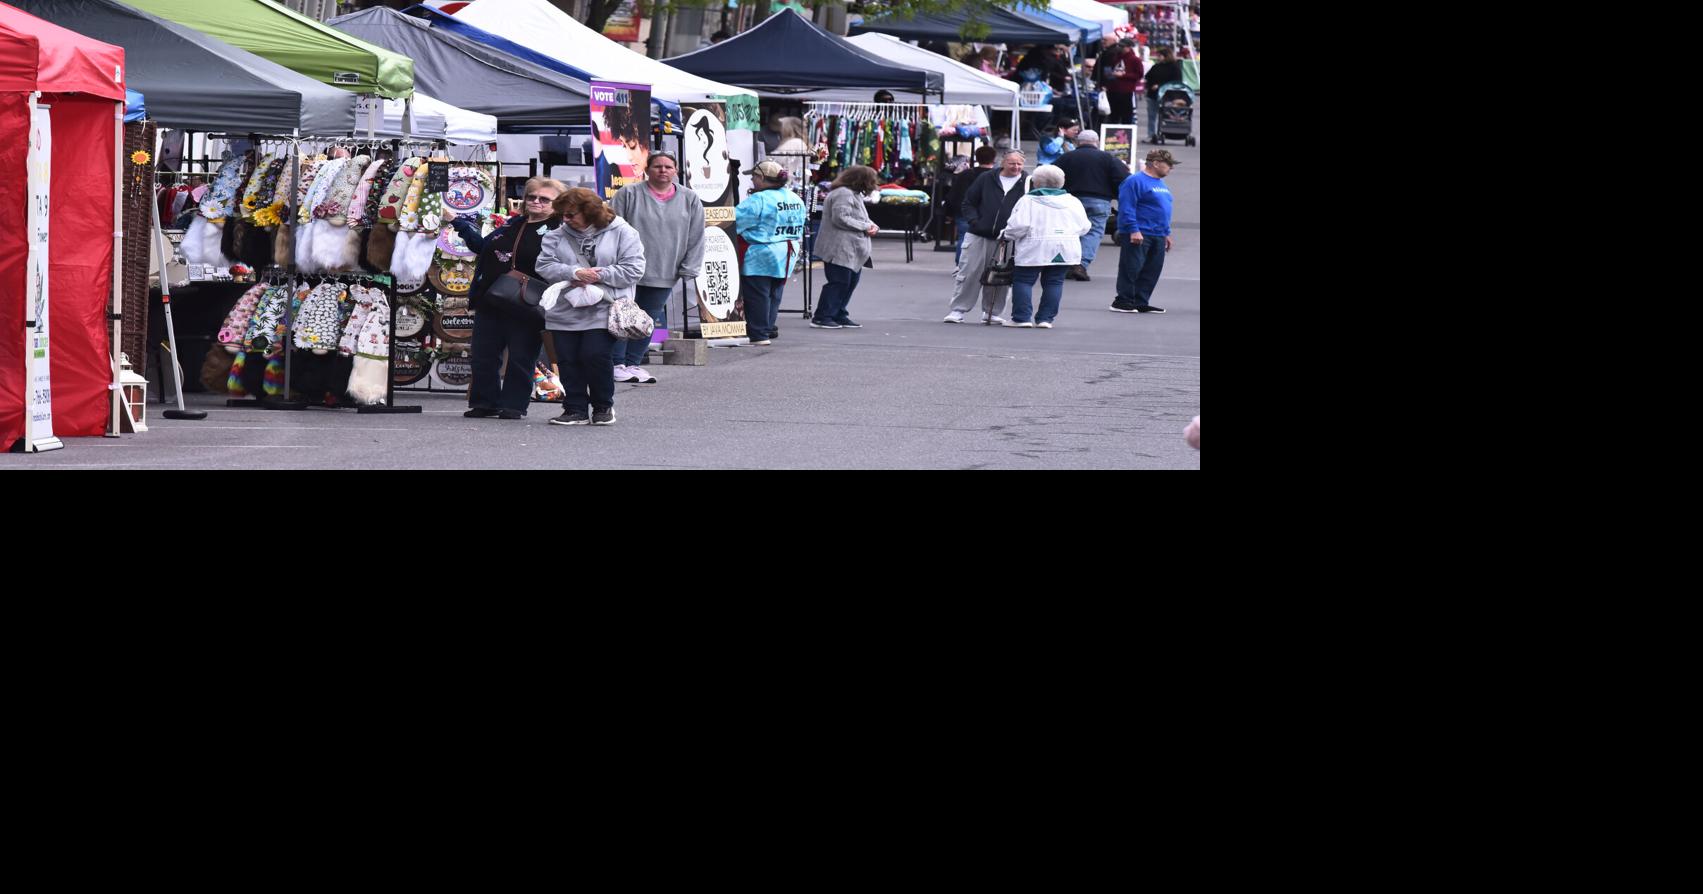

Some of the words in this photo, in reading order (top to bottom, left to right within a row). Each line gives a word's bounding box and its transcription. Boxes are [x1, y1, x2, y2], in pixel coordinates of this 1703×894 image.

[594, 91, 614, 102] VOTE
[616, 93, 628, 104] 411
[775, 225, 803, 236] STAFF
